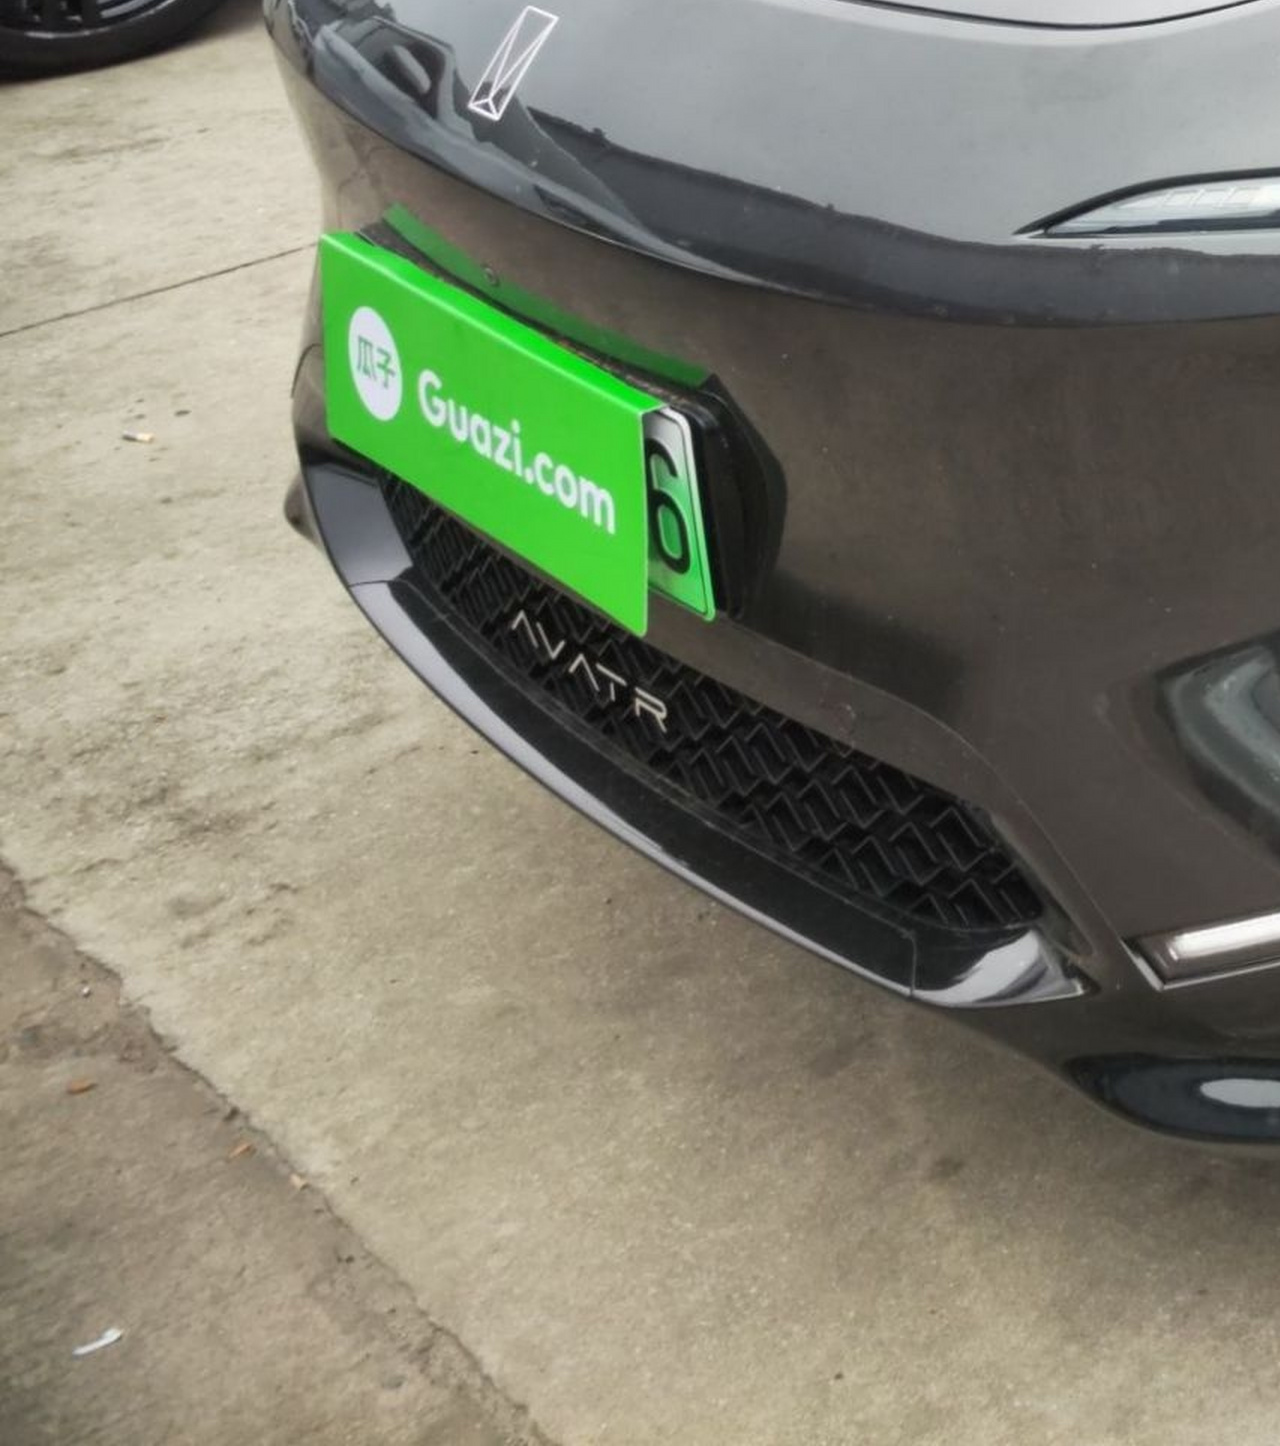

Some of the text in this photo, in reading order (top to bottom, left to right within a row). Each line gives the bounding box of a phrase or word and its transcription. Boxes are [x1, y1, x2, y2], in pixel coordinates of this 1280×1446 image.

[356, 335, 397, 390] 瓜子
[417, 368, 617, 536] Guazi.com
[643, 437, 692, 575] 6
[511, 608, 668, 734] AVATR
